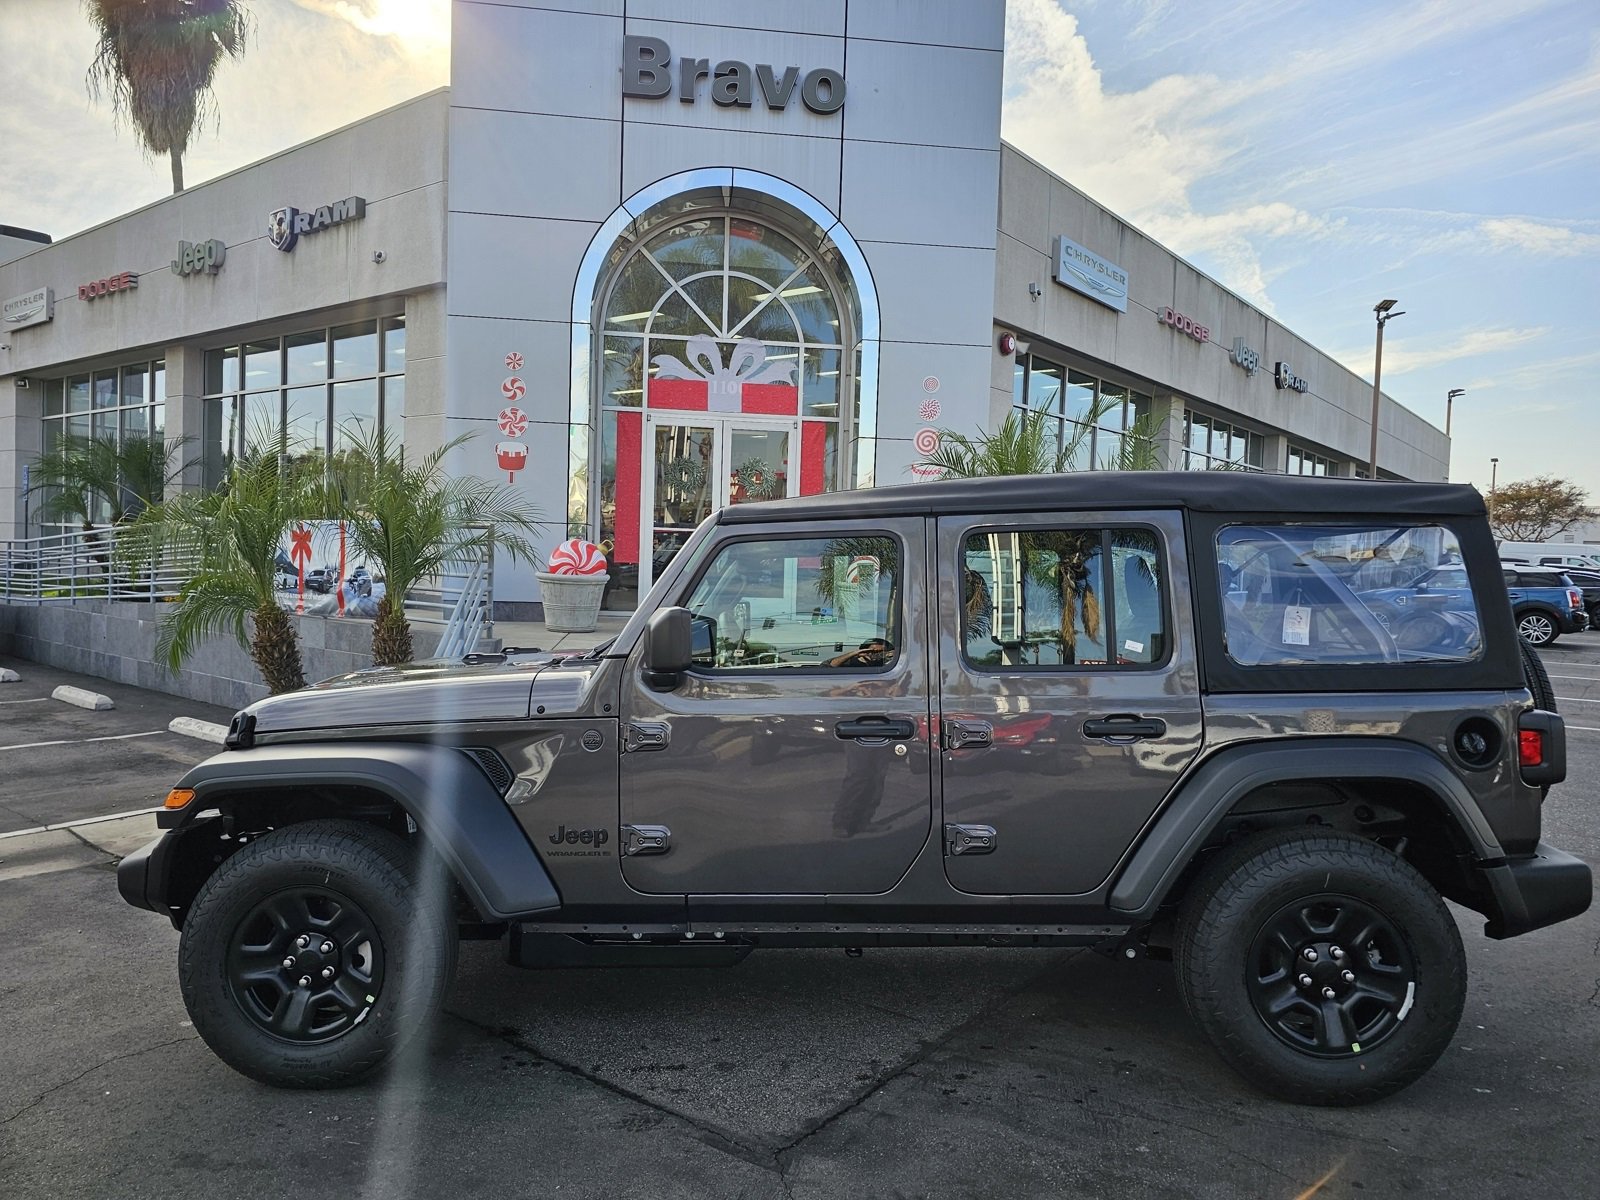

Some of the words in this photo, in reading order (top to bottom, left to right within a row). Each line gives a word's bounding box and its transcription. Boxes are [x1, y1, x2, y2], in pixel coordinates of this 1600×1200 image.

[623, 35, 846, 114] Bravo
[294, 196, 364, 236] RAM
[171, 238, 225, 276] Jeep
[1064, 244, 1127, 286] CHRYSLER
[4, 292, 44, 312] CHRYSLER
[78, 271, 137, 301] DODGE
[1162, 306, 1210, 343] DODGE
[1232, 337, 1260, 377] Jeep
[711, 380, 742, 395] 110
[1288, 373, 1308, 393] RAM
[548, 824, 609, 849] Jeep
